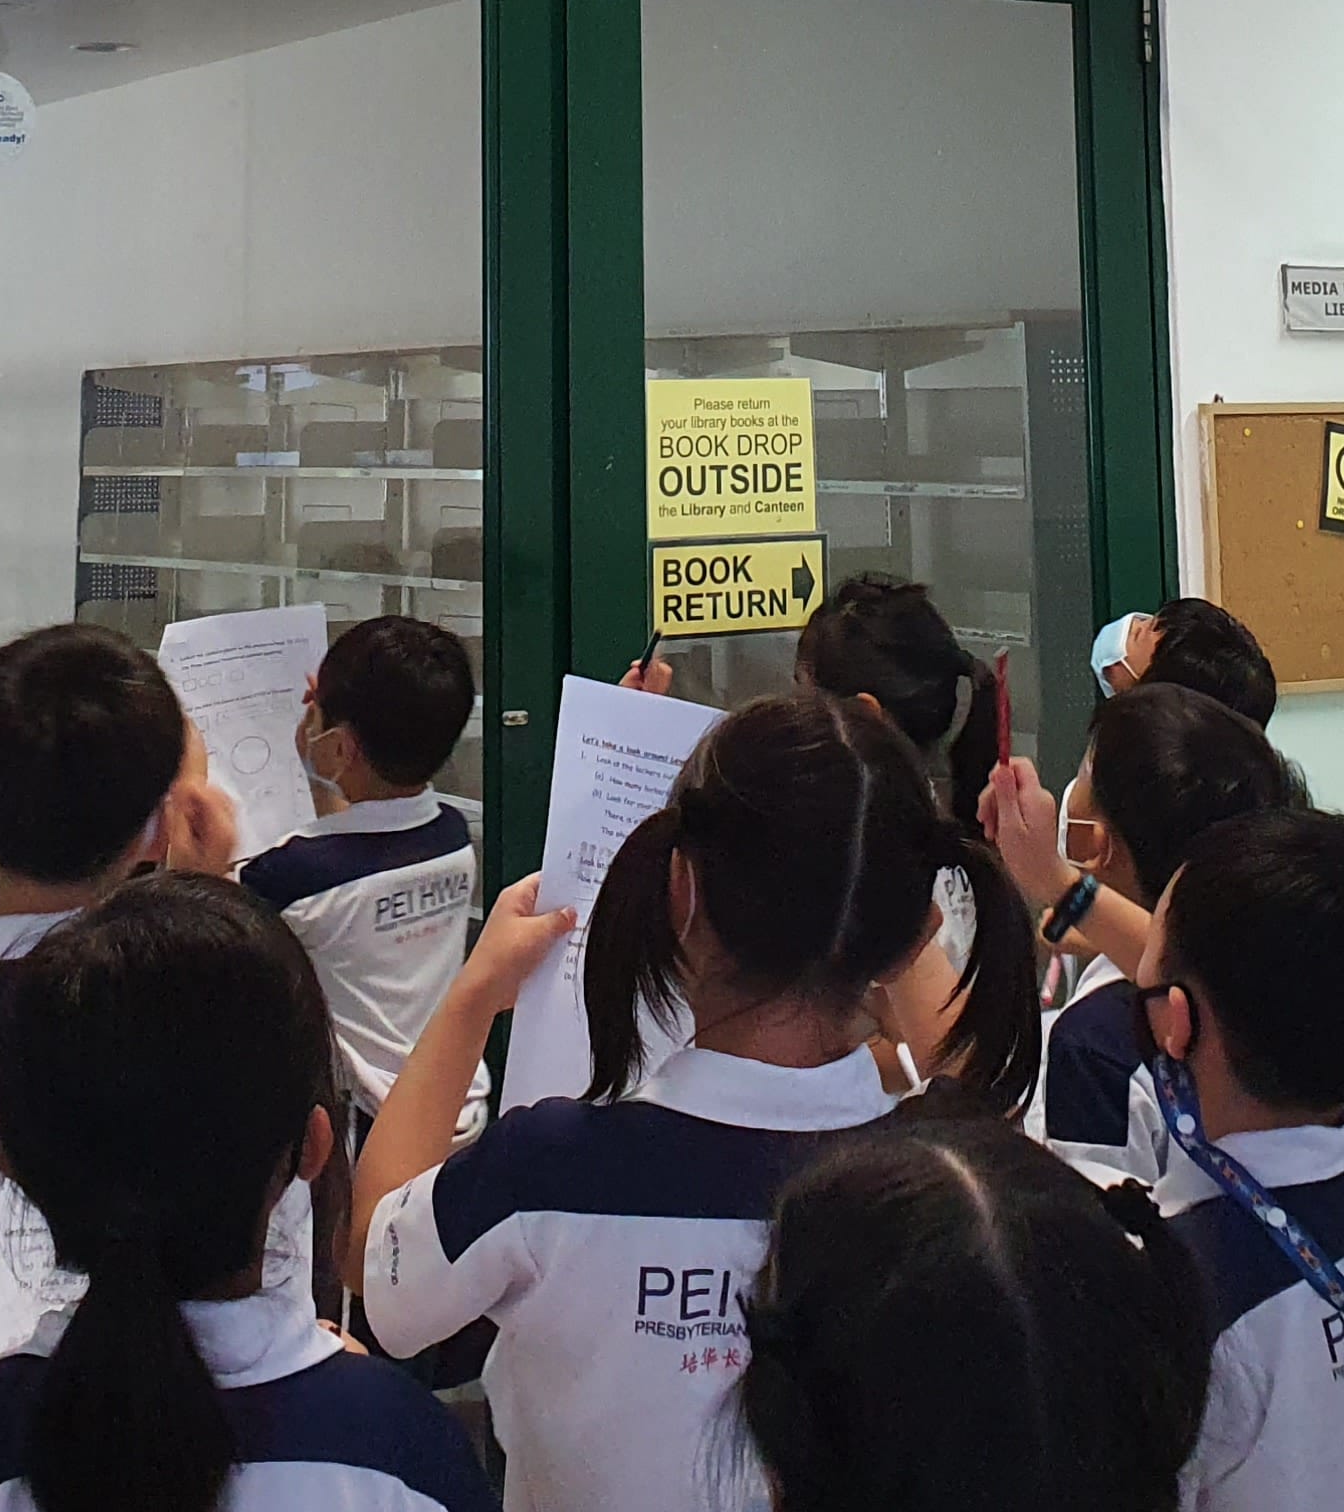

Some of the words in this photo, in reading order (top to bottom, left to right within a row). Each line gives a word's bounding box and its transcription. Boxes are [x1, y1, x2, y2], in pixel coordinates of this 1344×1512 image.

[1290, 281, 1340, 296] MEDIA
[693, 397, 734, 411] Please
[737, 398, 771, 410] return
[661, 417, 687, 433] your
[690, 415, 727, 431] library
[730, 415, 764, 428] books
[767, 416, 779, 427] at
[781, 414, 799, 426] the
[659, 434, 730, 458] BOOK
[737, 432, 803, 456] DROP
[659, 462, 804, 497] OUTSIDE
[658, 504, 678, 518] the
[681, 503, 726, 519] Library
[729, 502, 751, 515] and
[754, 500, 805, 514] Canteen
[1331, 506, 1344, 516] OR
[662, 554, 754, 588] BOOK
[662, 587, 788, 623] RETURN
[374, 889, 414, 924] PEI
[637, 1265, 731, 1321] PEI
